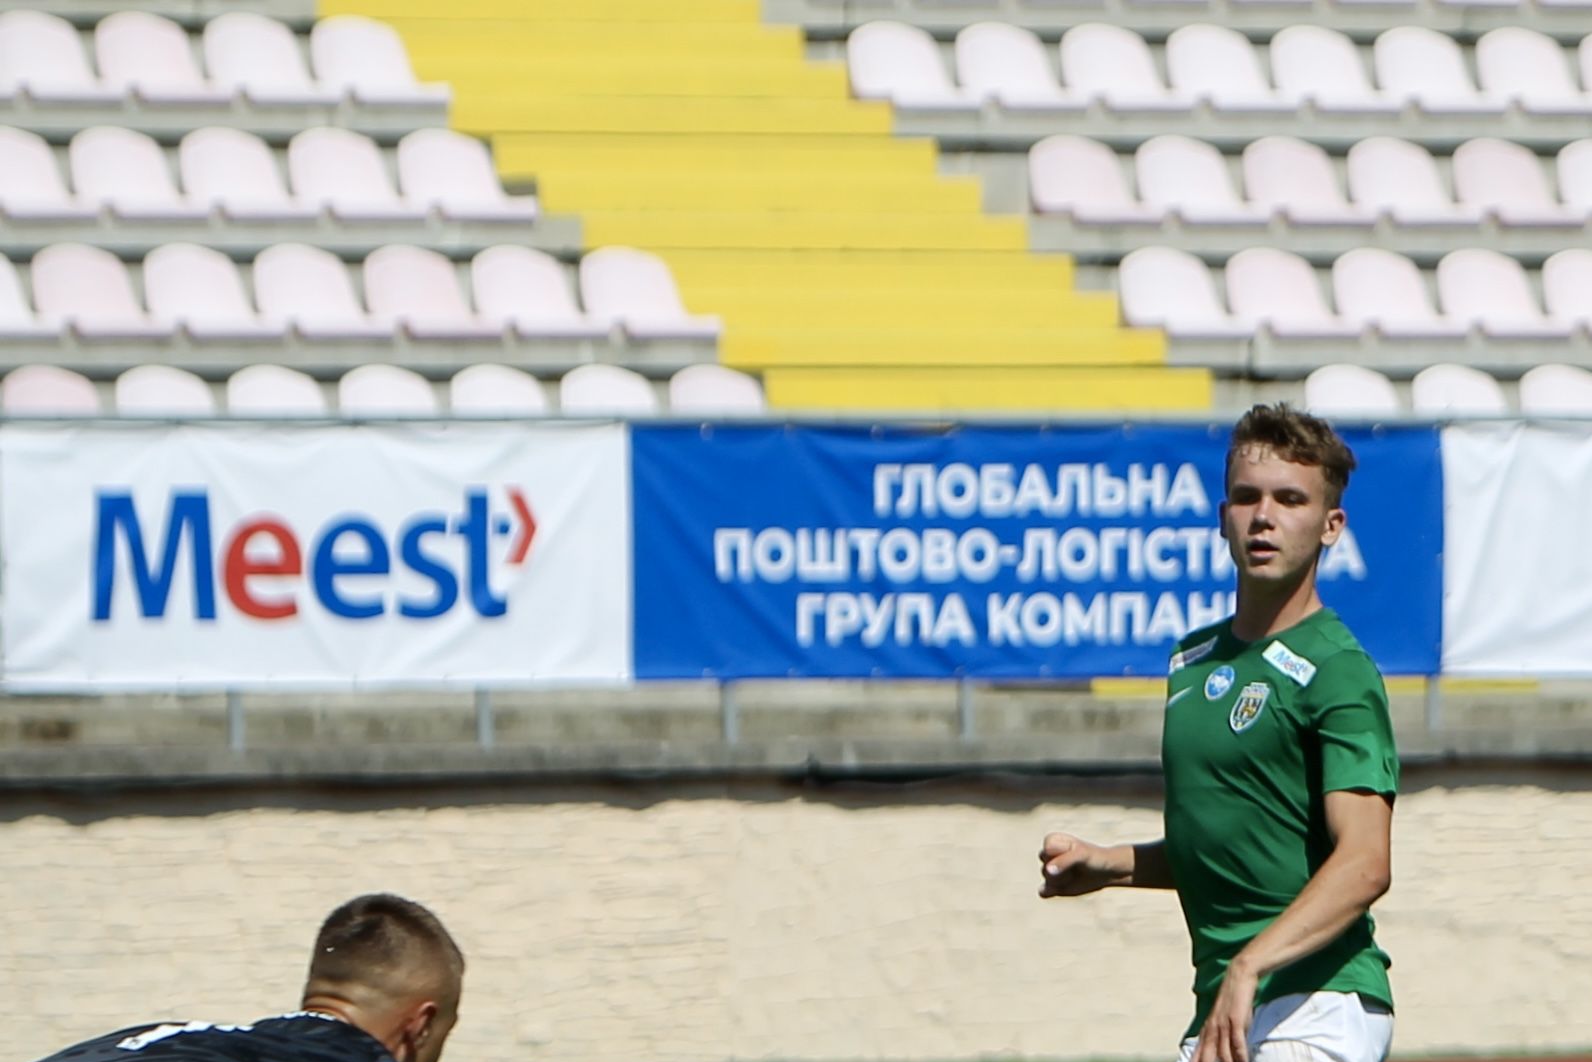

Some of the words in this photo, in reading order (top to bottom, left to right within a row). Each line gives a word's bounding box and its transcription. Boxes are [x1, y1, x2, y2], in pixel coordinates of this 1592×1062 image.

[873, 463, 1208, 517] ГЛОБАЛЬНА
[91, 486, 510, 622] Meest
[713, 527, 1368, 582] ПОШТОВО-ЛОГІСТИА
[797, 592, 977, 647] ГРУПА
[988, 592, 1238, 646] КОМПАН
